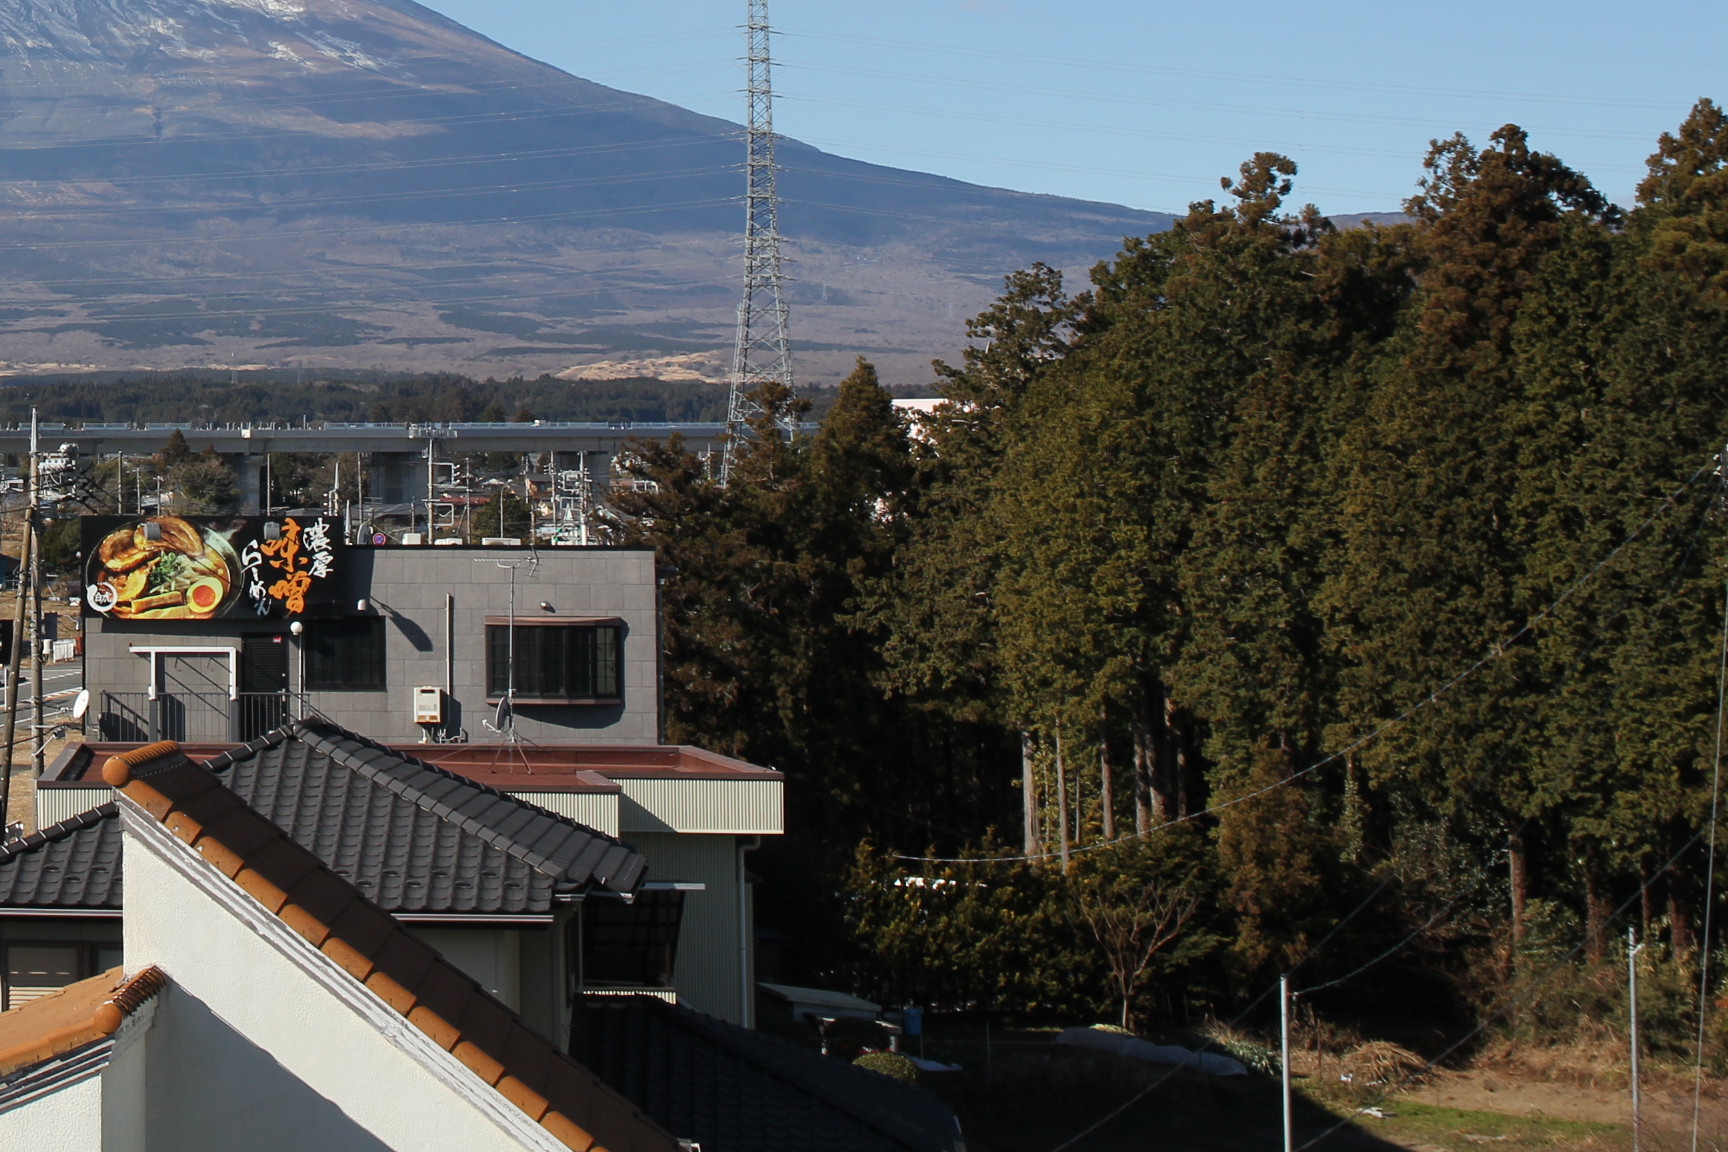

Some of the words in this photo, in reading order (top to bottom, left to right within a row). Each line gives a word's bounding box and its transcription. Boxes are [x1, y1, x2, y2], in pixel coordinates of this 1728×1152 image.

[241, 539, 272, 616] らーめん
[260, 517, 312, 617] 味噌
[302, 517, 334, 578] 濃厚
